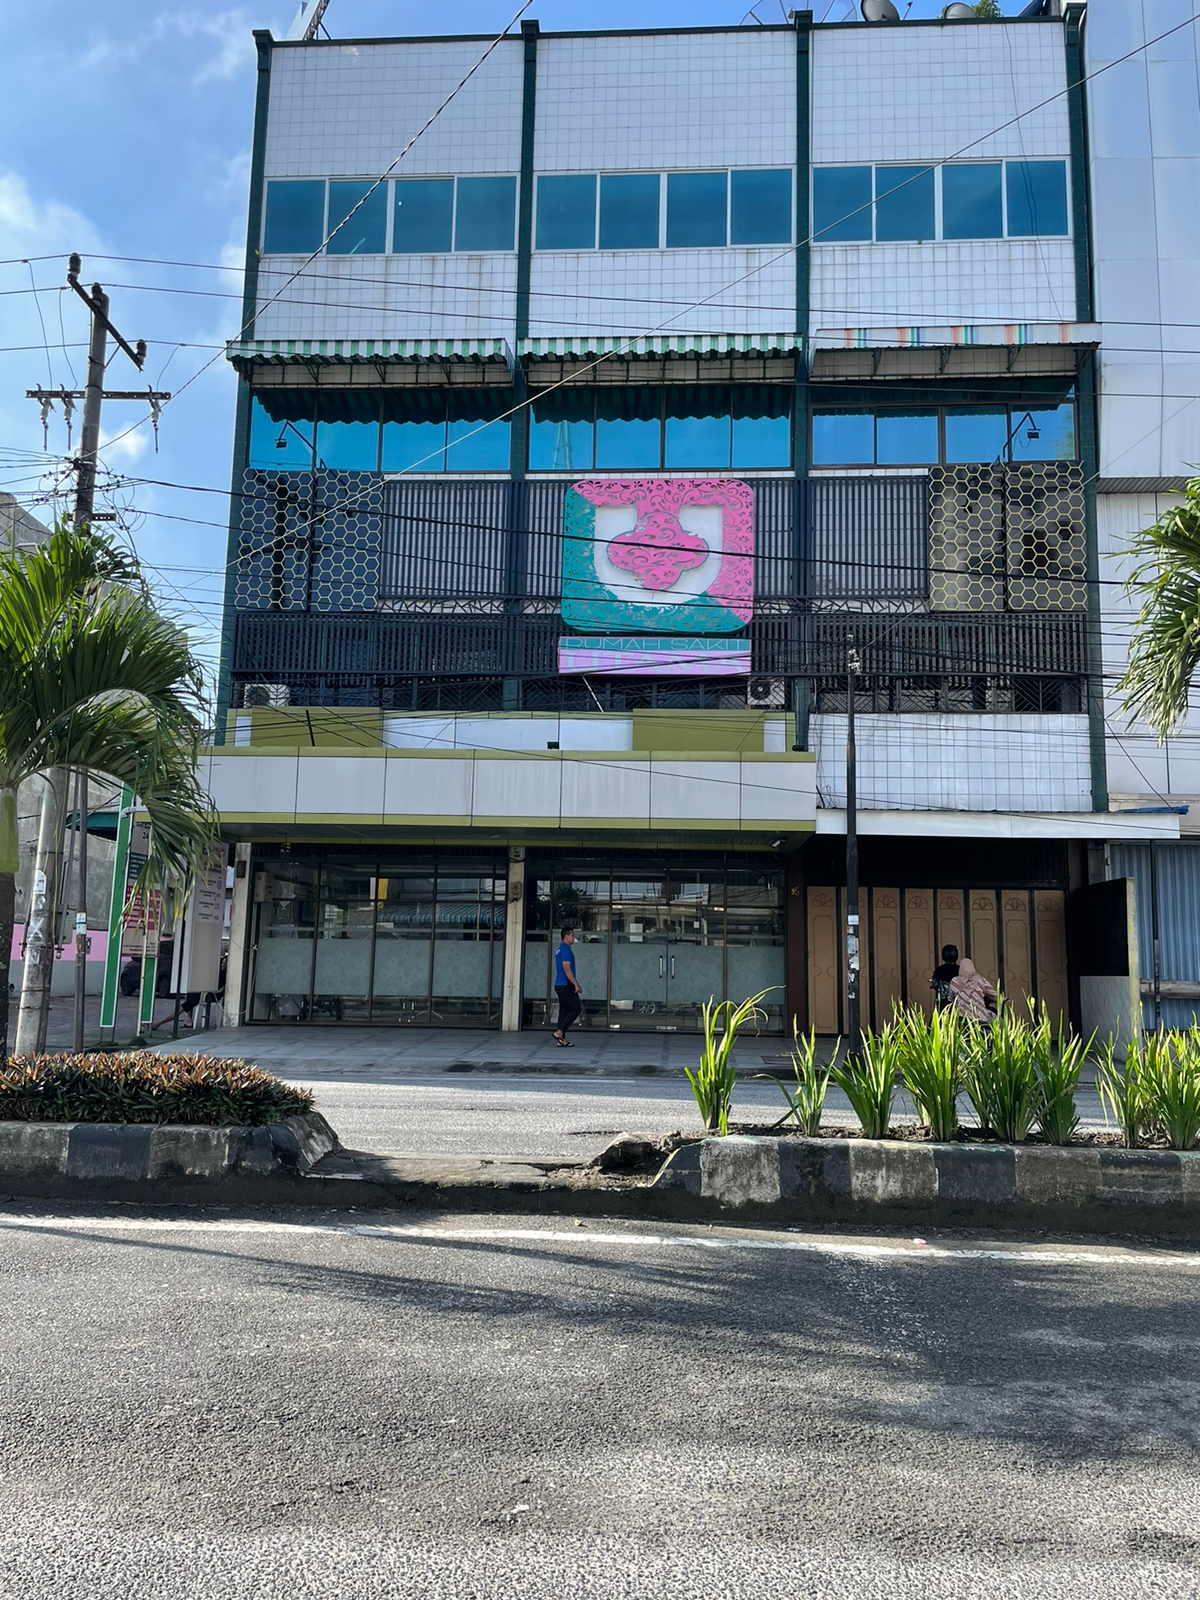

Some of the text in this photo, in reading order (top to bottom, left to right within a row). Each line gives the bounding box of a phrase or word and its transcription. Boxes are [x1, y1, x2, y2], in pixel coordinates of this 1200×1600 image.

[566, 638, 744, 650] RUMAH SAKIT
[564, 652, 746, 674] UTAMA
